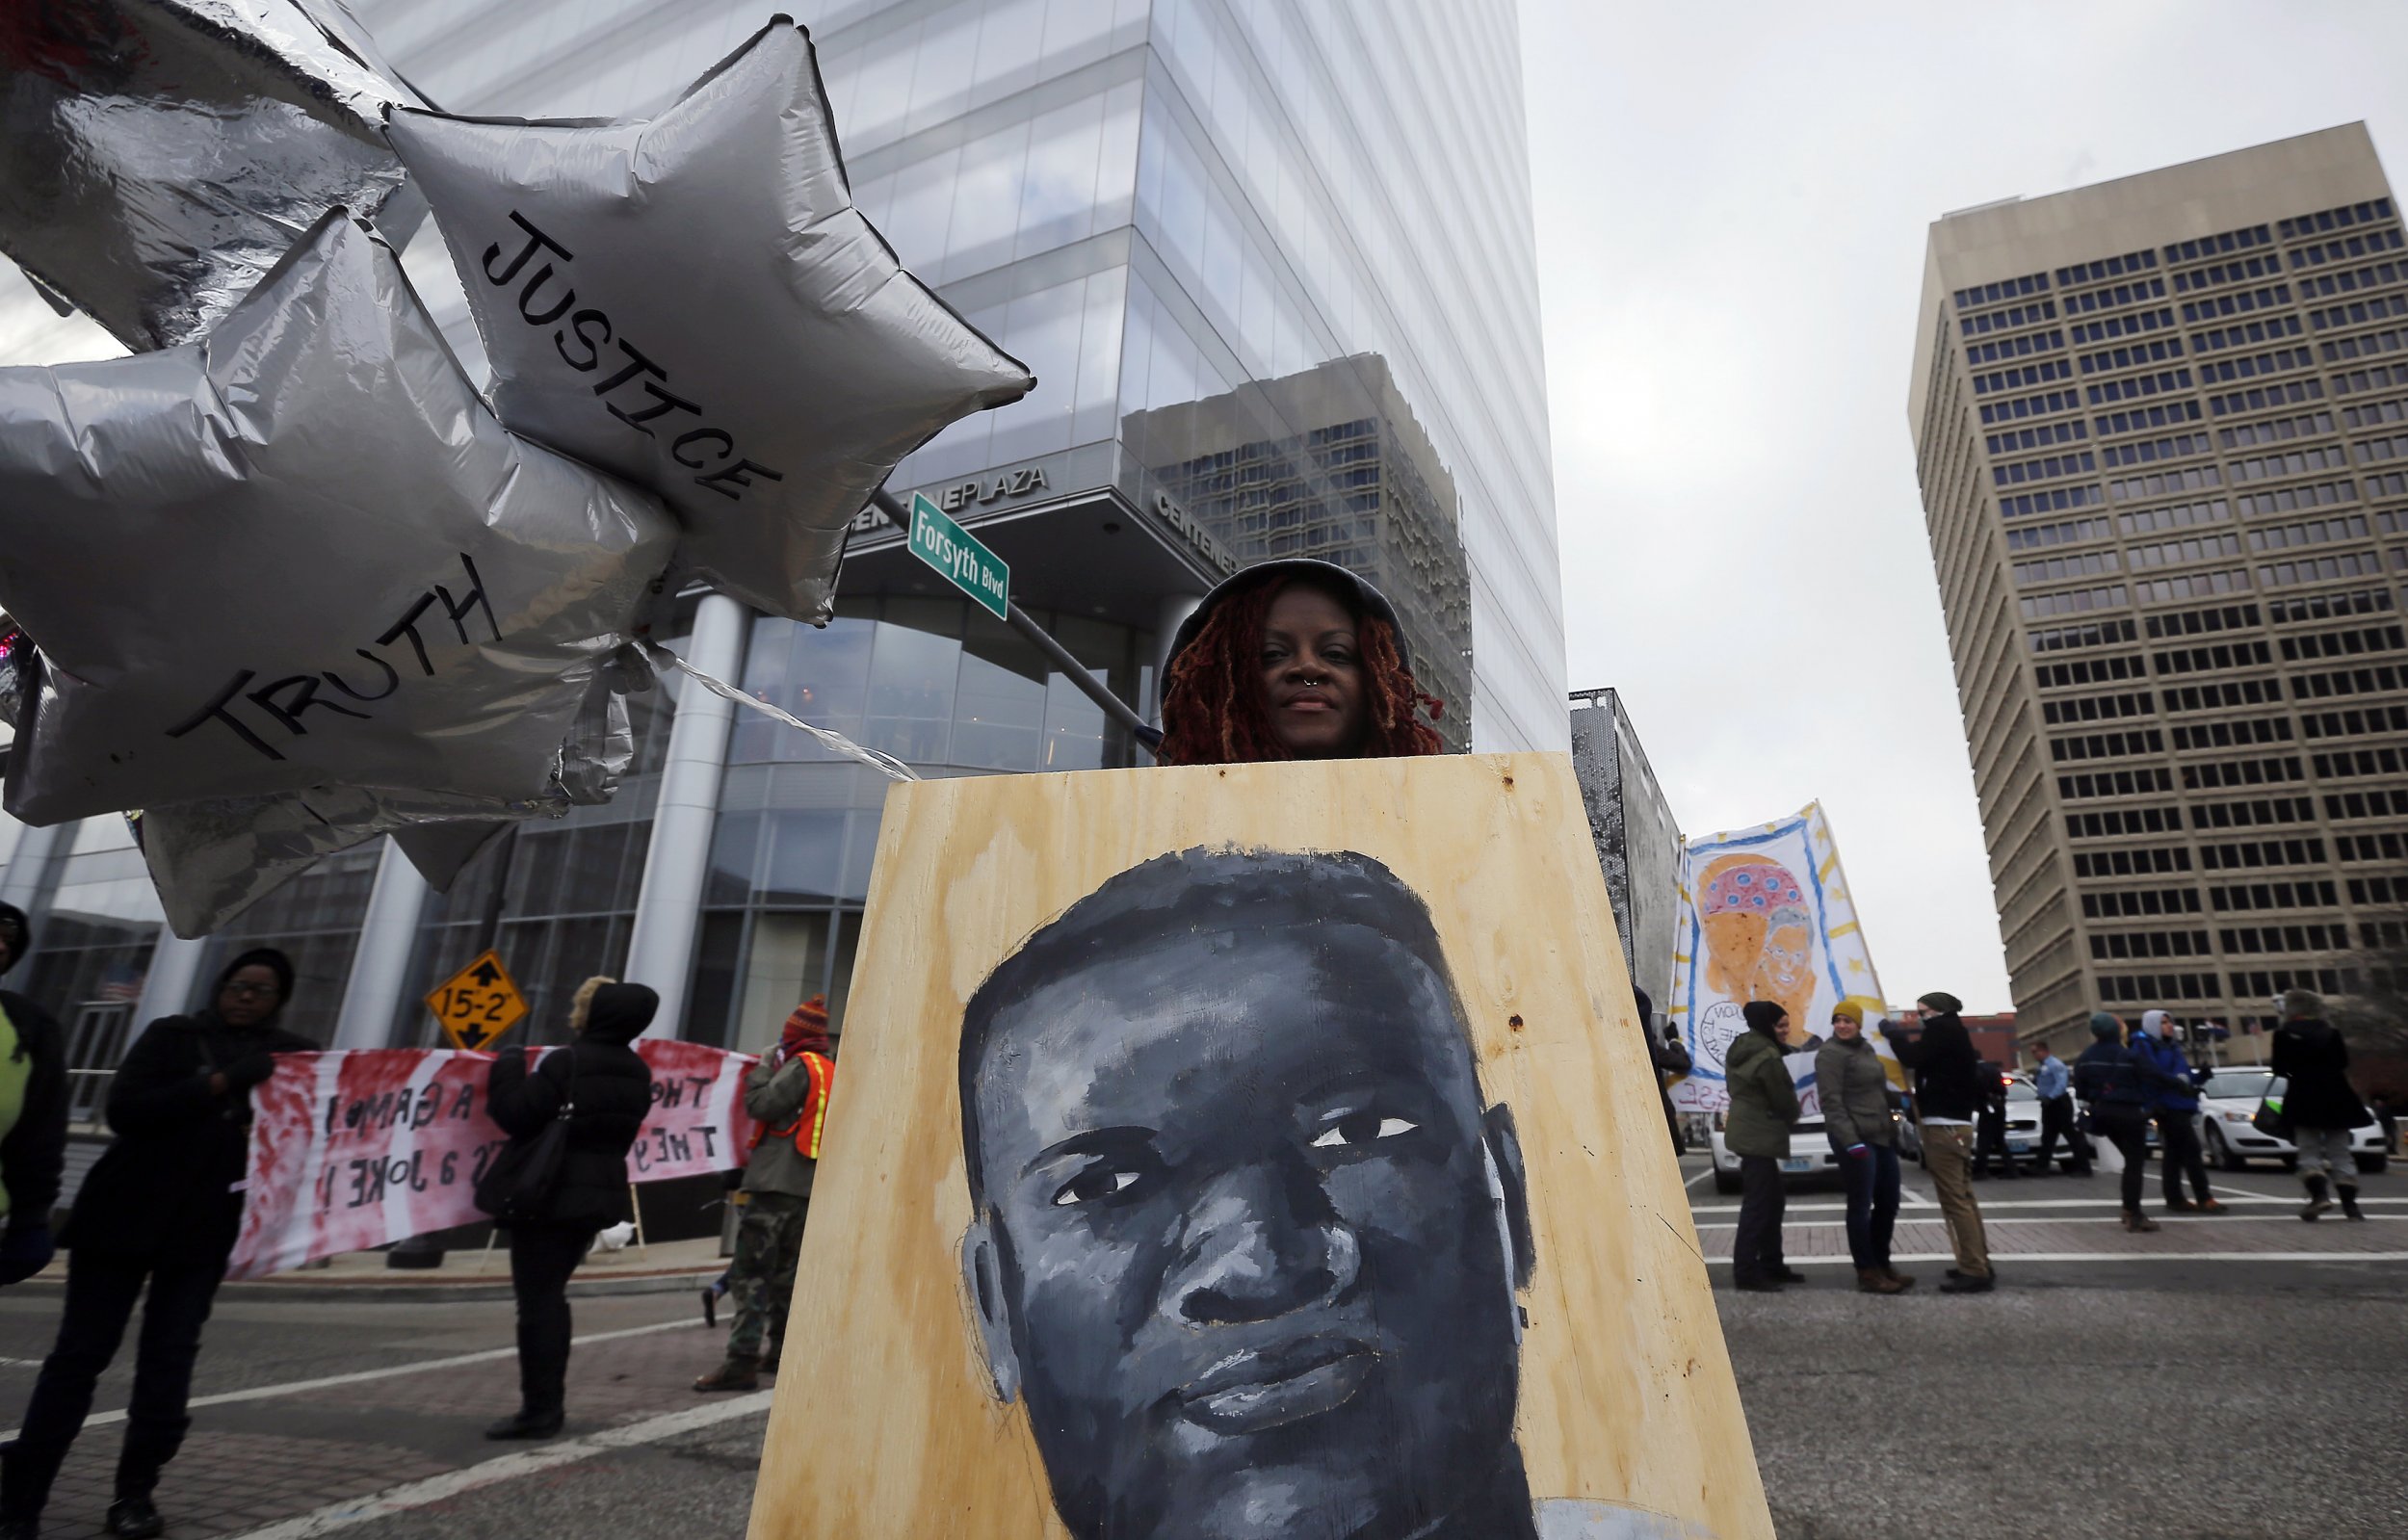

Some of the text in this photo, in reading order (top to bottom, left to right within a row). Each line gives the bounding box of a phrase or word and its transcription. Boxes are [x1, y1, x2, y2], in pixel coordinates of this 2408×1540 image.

[483, 209, 783, 501] JUSTICE
[165, 552, 502, 761] TRUTH
[916, 509, 1004, 599] Forsyth Blvd
